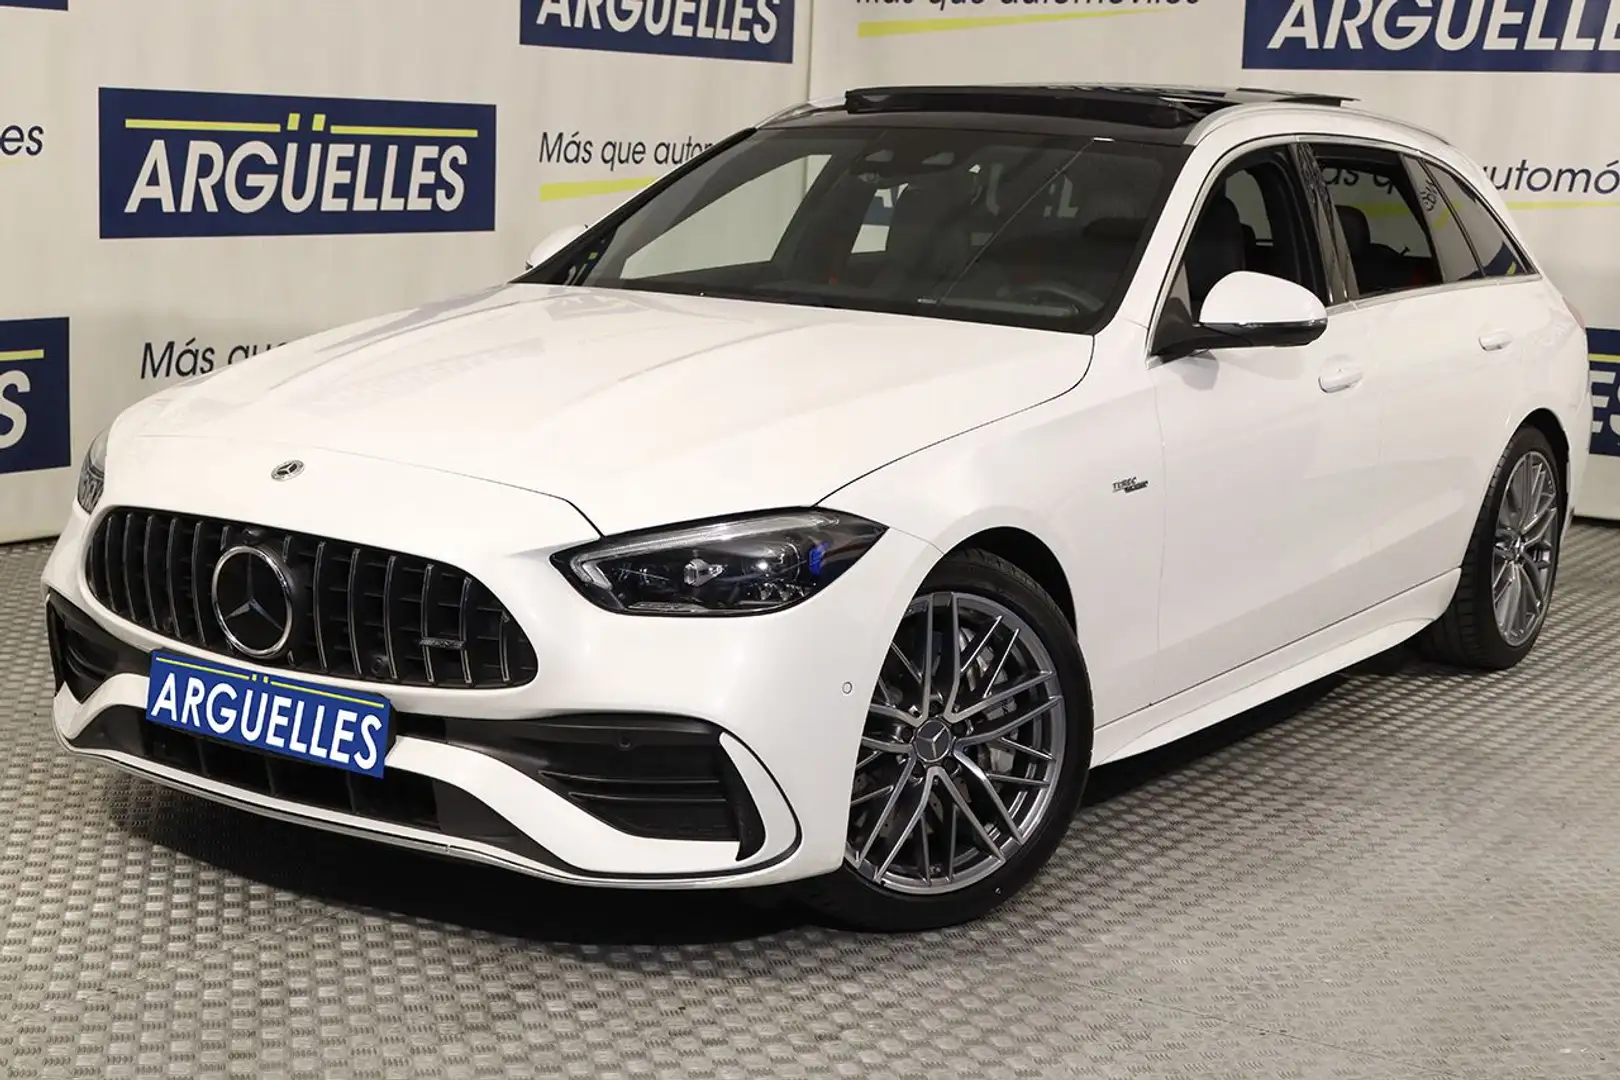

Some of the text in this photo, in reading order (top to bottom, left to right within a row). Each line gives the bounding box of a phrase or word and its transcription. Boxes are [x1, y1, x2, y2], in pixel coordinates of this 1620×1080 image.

[124, 113, 468, 213] ARGÜELLES
[539, 131, 593, 164] Más
[601, 141, 646, 172] que
[1483, 159, 1620, 195] utomó
[138, 337, 215, 379] Más
[151, 672, 382, 770] ARGÜELLES
